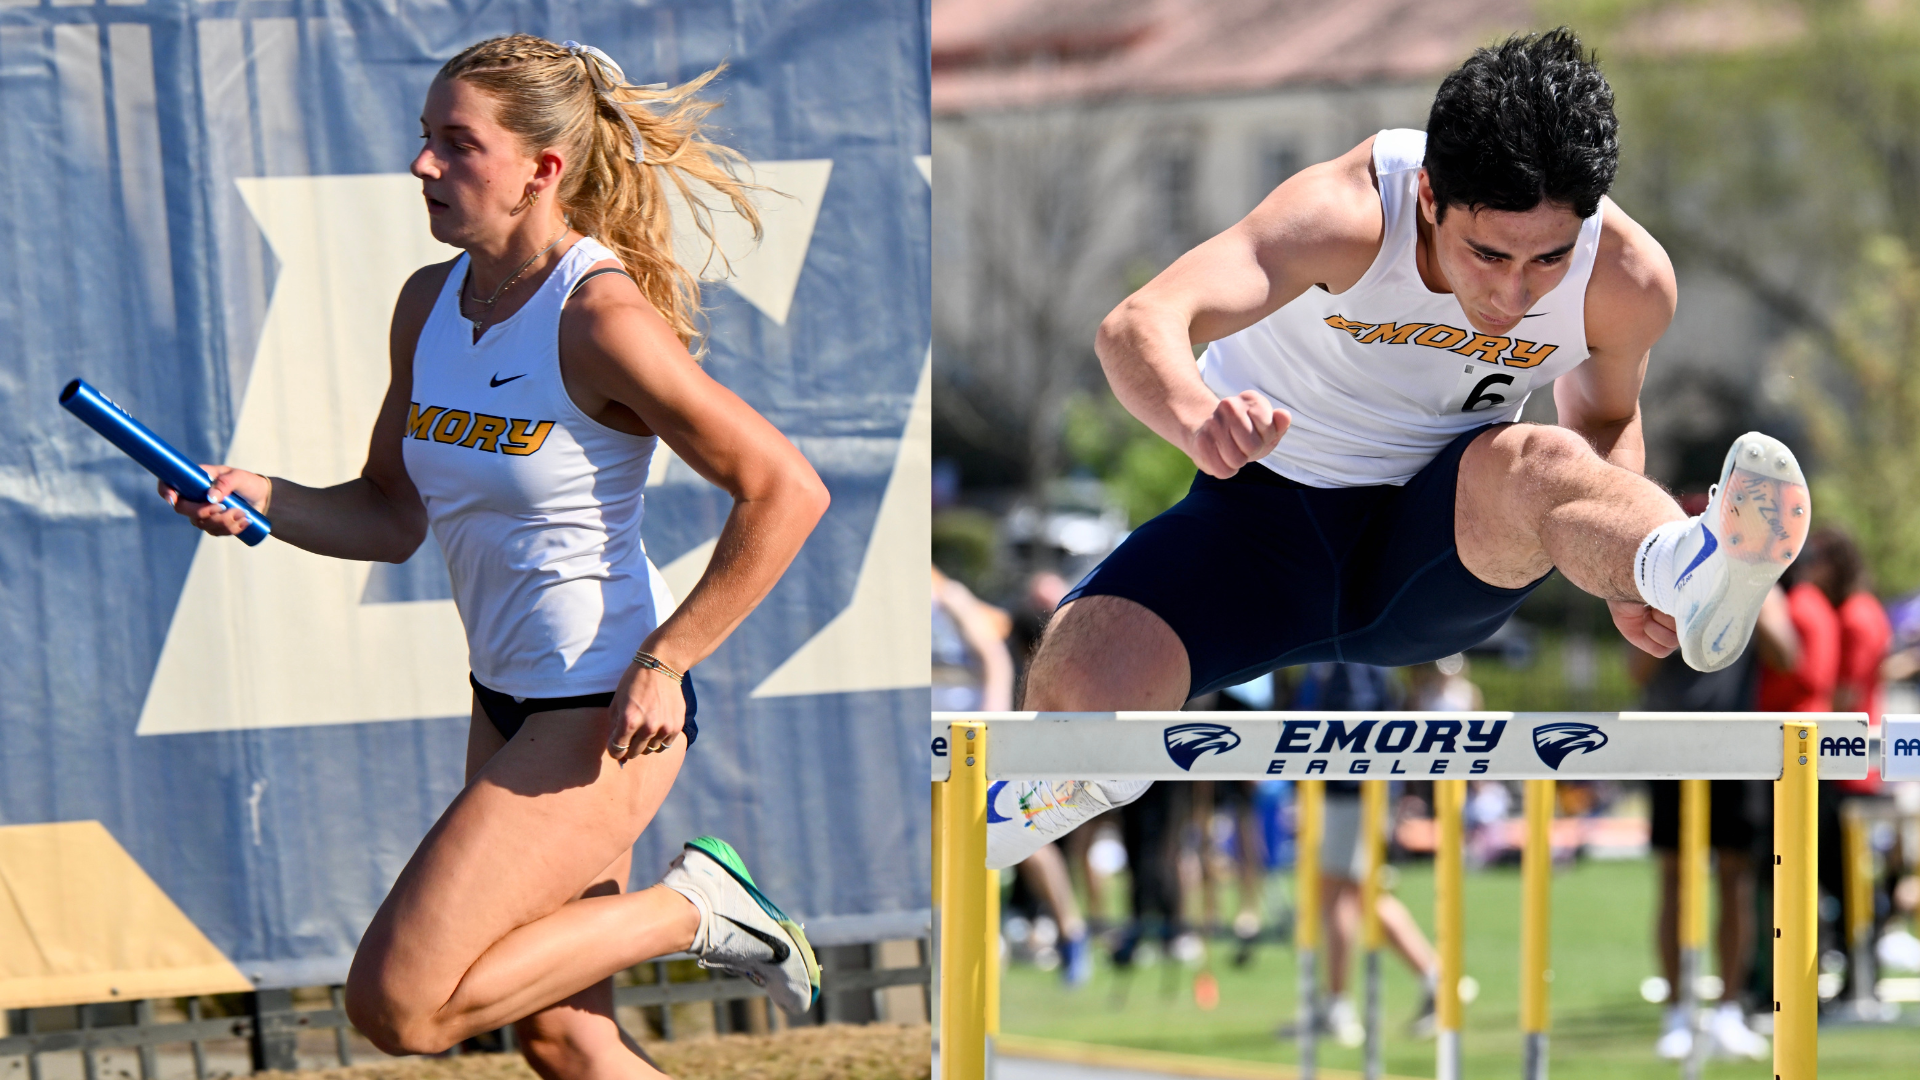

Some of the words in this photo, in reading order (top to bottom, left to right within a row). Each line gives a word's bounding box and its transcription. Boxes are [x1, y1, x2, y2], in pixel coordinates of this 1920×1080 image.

[1461, 373, 1515, 412] 6
[1274, 720, 1508, 753] EMORY
[1266, 759, 1491, 774] EAGLES
